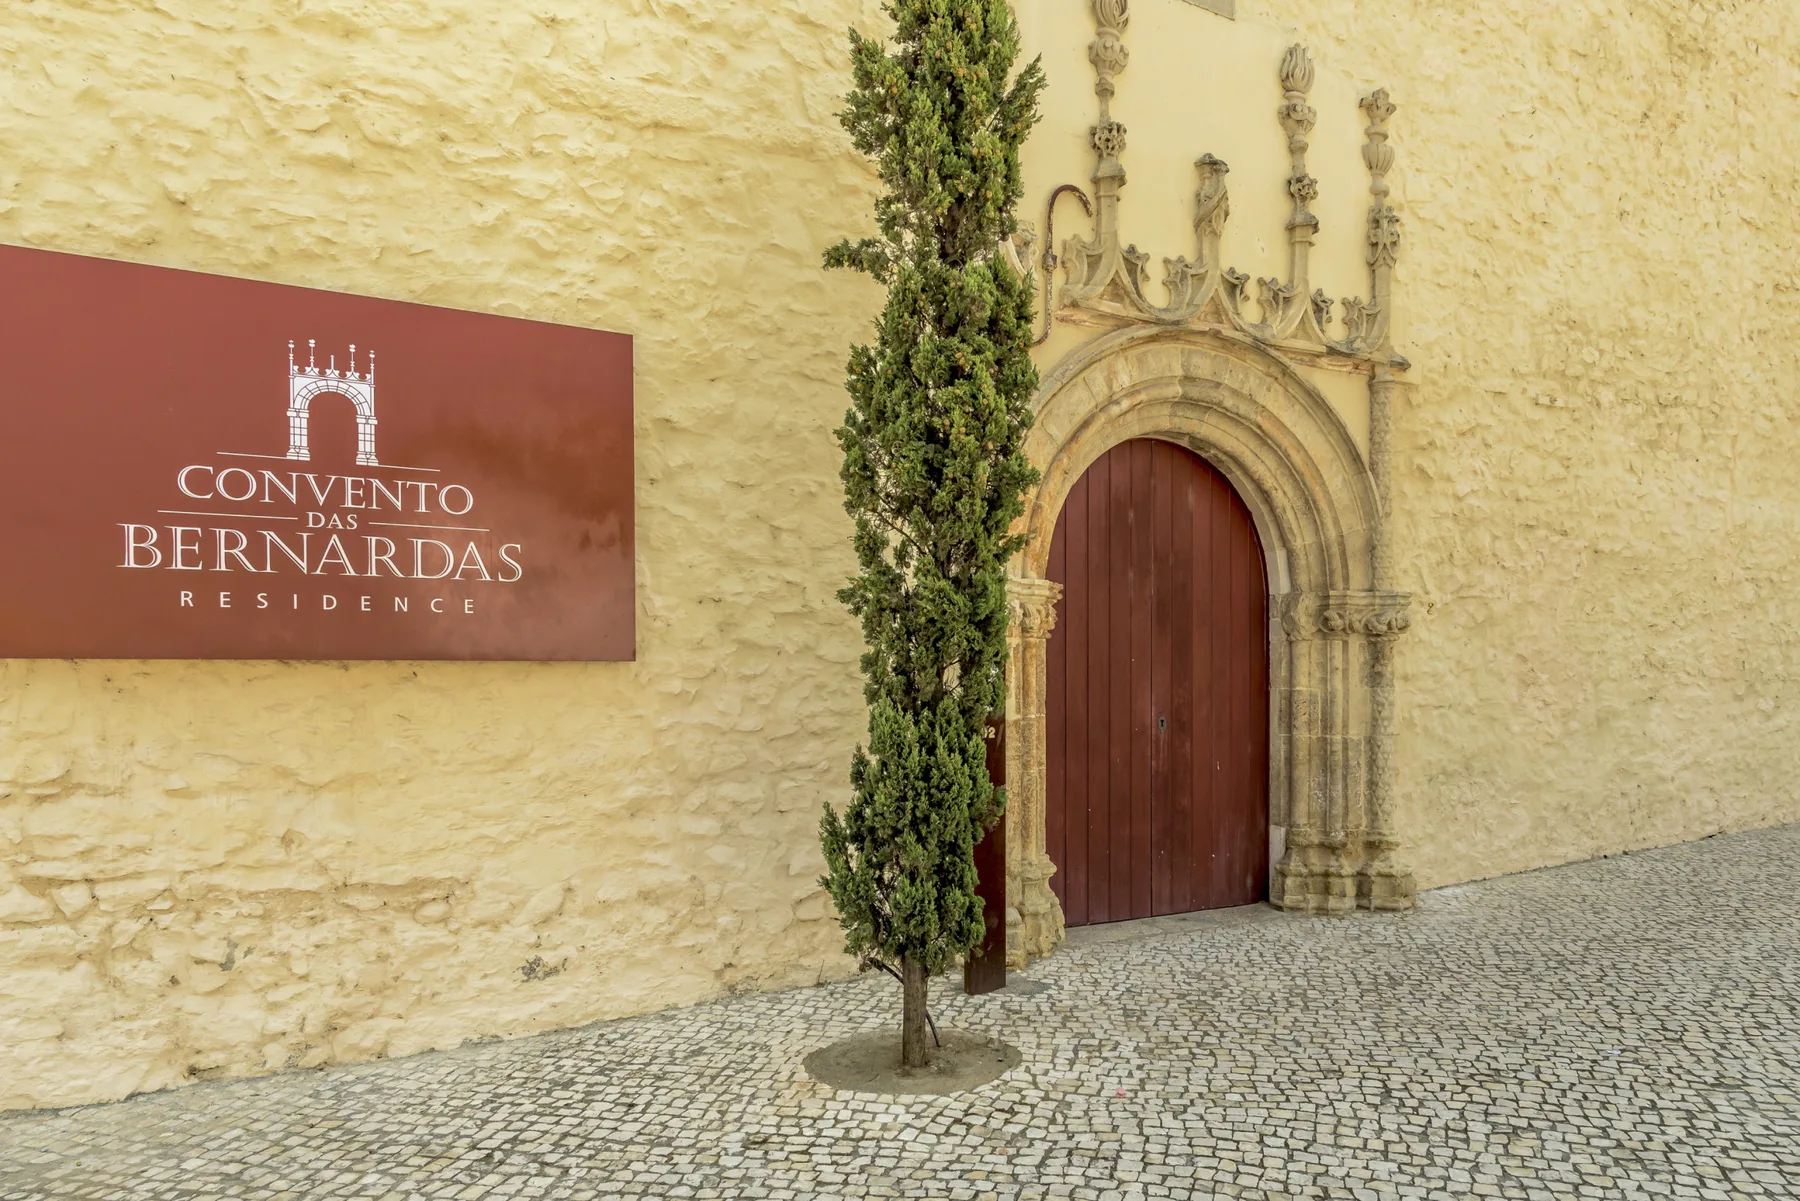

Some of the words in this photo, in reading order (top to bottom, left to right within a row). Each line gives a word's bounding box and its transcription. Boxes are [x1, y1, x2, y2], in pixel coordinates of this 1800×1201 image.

[177, 464, 474, 515] CONVENTO
[306, 511, 358, 530] DAS
[116, 523, 523, 582] BERNARDAS
[180, 590, 475, 614] RESIDENCE
